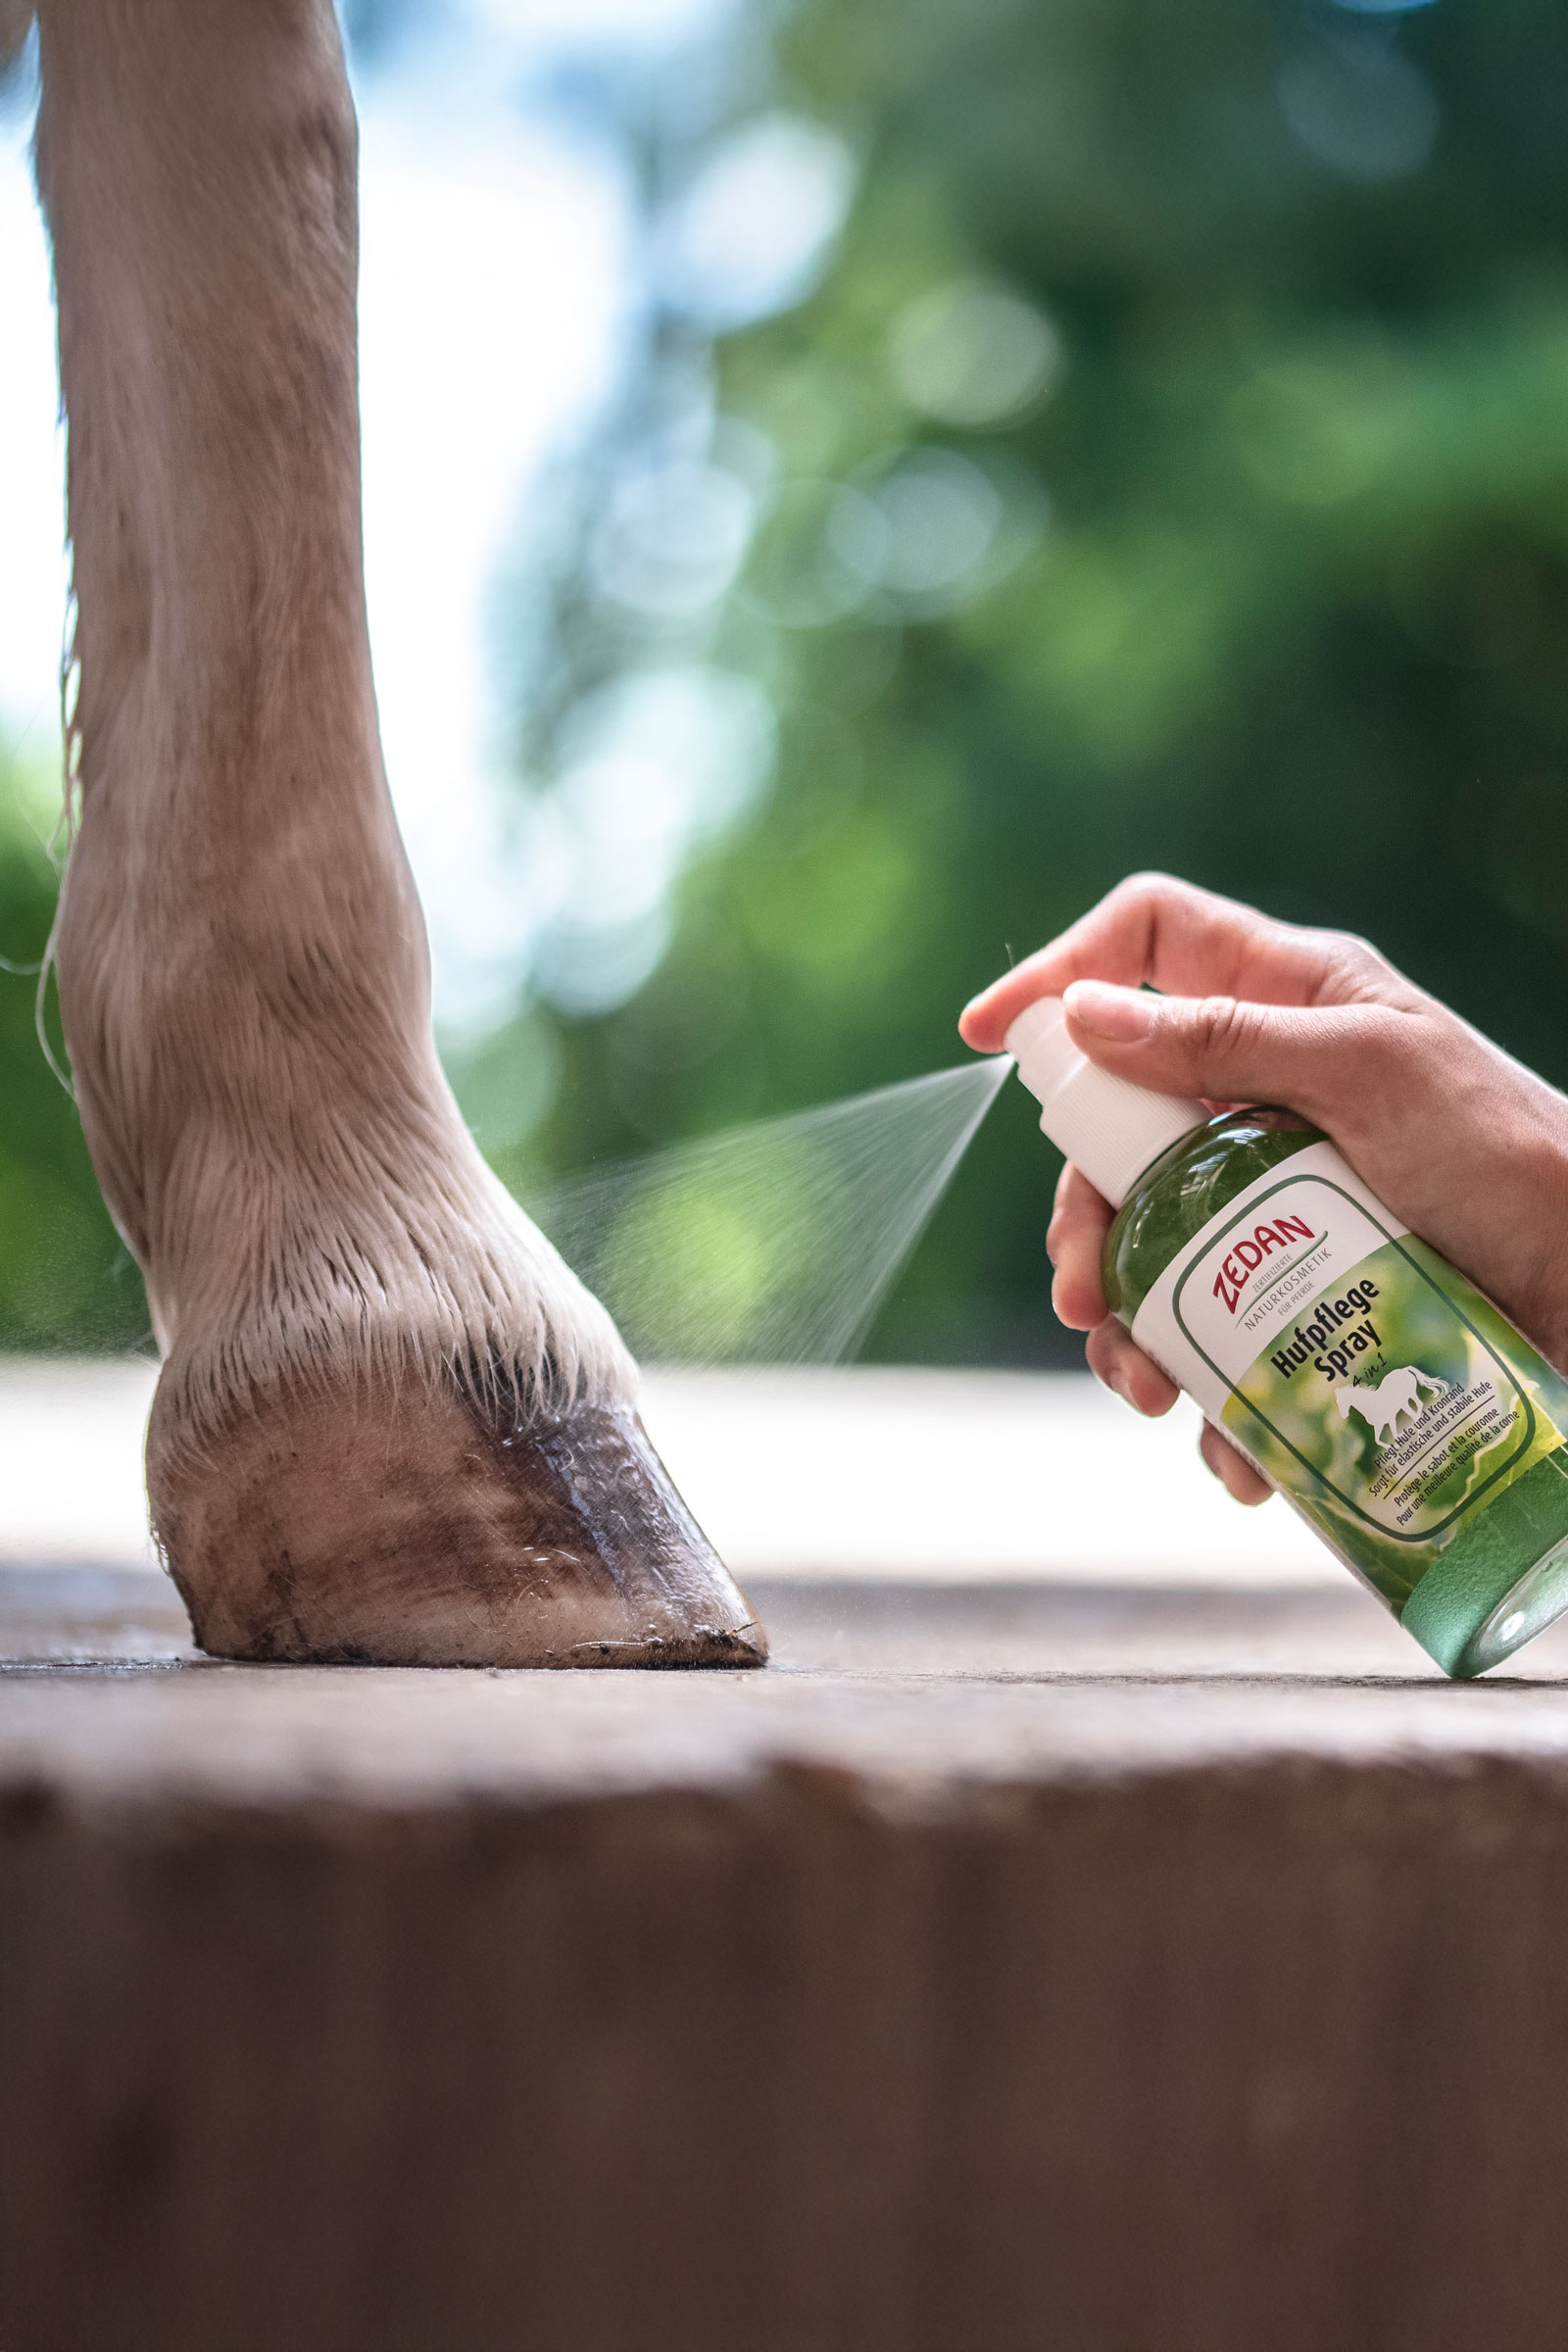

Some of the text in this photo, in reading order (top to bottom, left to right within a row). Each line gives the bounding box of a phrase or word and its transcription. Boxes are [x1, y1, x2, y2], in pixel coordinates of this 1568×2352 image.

[1212, 1215, 1315, 1314] ZEDAN
[1244, 1248, 1333, 1331] NATURKOSMETIK
[1252, 1252, 1294, 1294] ZERTIFIZIERTE
[1277, 1280, 1315, 1316] FÜR PFERDE
[1270, 1279, 1380, 1379] Hufpflege
[1313, 1320, 1382, 1382] Spray
[1352, 1351, 1387, 1388] 4 in 1
[1368, 1382, 1493, 1496] Sorgt für elastische und stabile Hufe
[1374, 1382, 1465, 1469] Pflegt Hufe und Kronrand
[1394, 1408, 1499, 1507] Protège le sabot et la couronne
[1396, 1410, 1520, 1526] Pour une meilleure qualité de la corne
